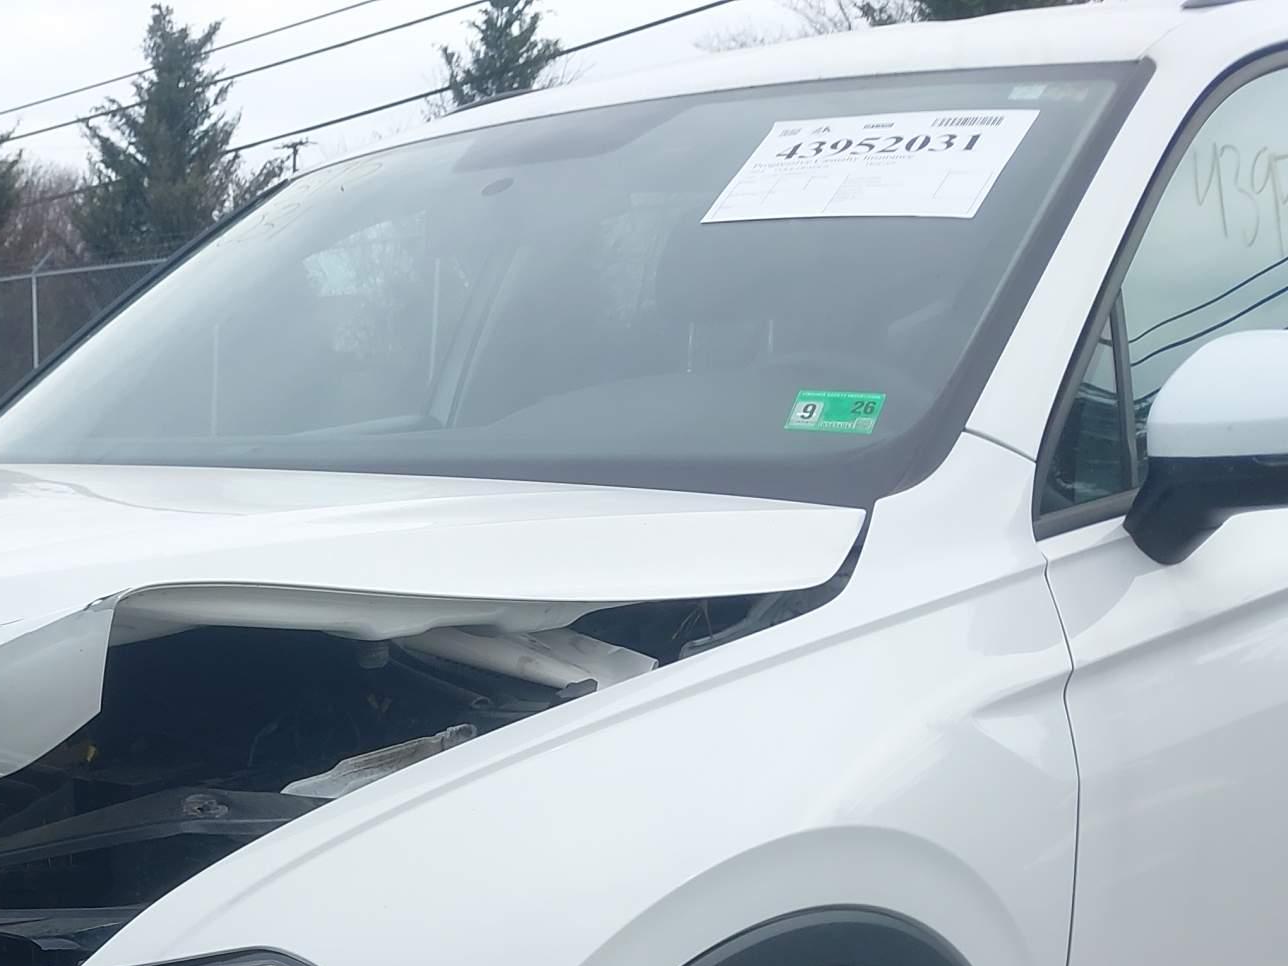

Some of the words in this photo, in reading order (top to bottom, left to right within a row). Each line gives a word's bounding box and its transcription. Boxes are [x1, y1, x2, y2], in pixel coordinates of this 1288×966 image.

[775, 133, 981, 160] 43952031
[800, 403, 817, 419] 9
[850, 400, 876, 416] 26
